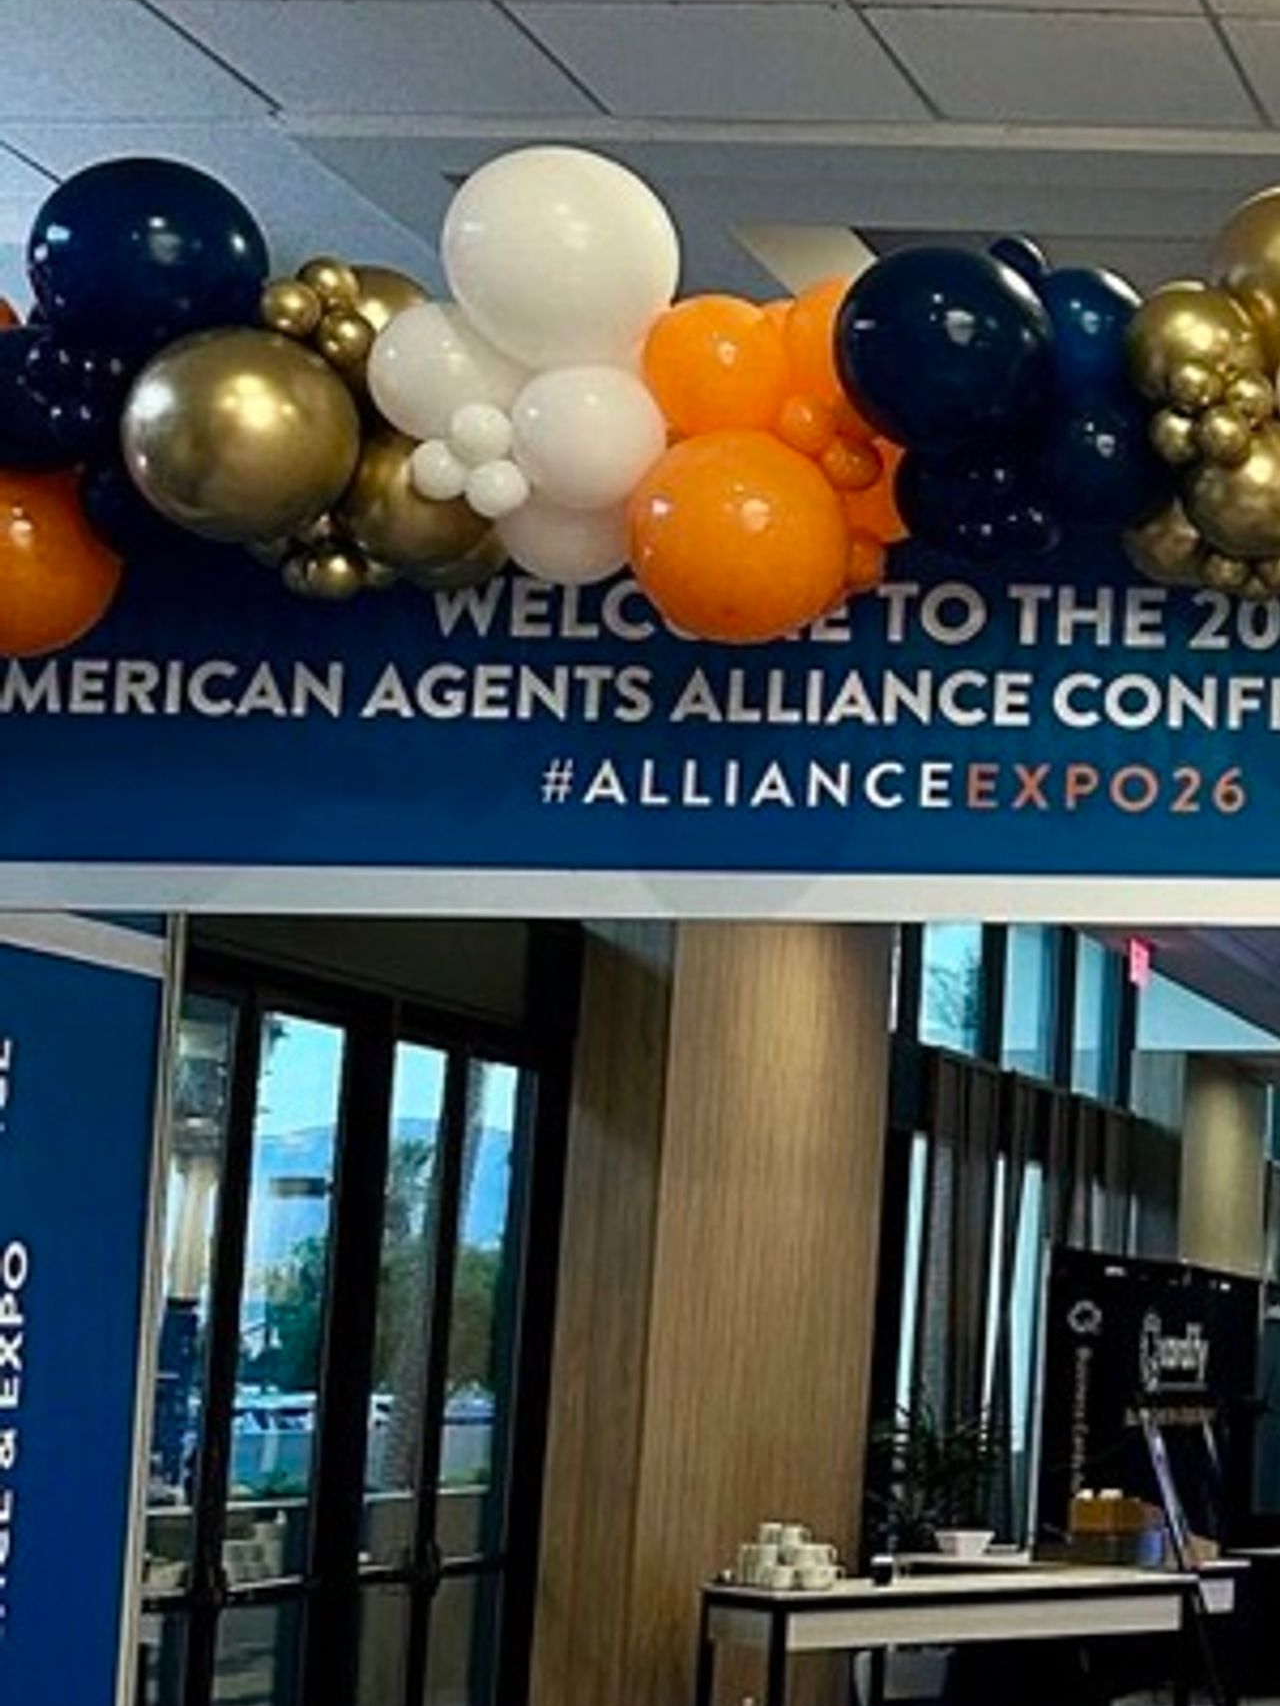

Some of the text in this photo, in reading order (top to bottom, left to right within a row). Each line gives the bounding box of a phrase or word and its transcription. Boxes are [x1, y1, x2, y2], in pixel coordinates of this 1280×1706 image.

[435, 577, 851, 643] WELCE
[881, 582, 986, 645] TO
[1010, 585, 1167, 648] THE
[0, 659, 344, 718] MERICAN
[361, 663, 652, 723] AGENTS
[671, 668, 1033, 727] ALLIANCE
[542, 758, 1246, 813] #ALLIANCEEXPO26
